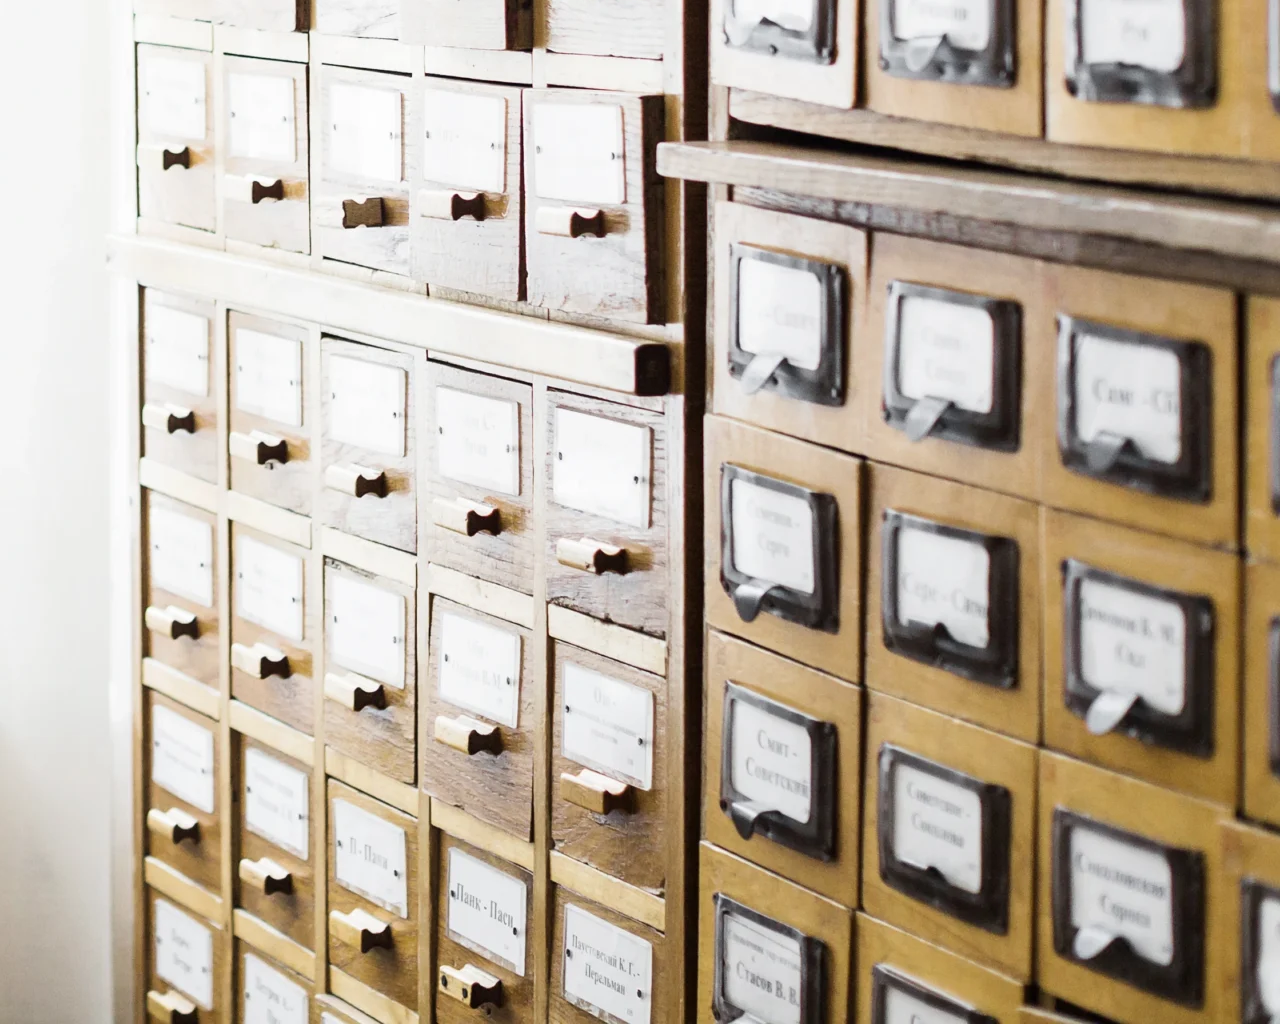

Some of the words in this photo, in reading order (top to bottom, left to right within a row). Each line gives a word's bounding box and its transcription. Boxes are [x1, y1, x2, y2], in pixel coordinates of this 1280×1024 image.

[456, 883, 481, 912] Панк
[489, 900, 514, 929] Паси
[572, 934, 617, 969] Паустовский
[585, 963, 626, 996] Перельман
[736, 960, 773, 994] Стасов
